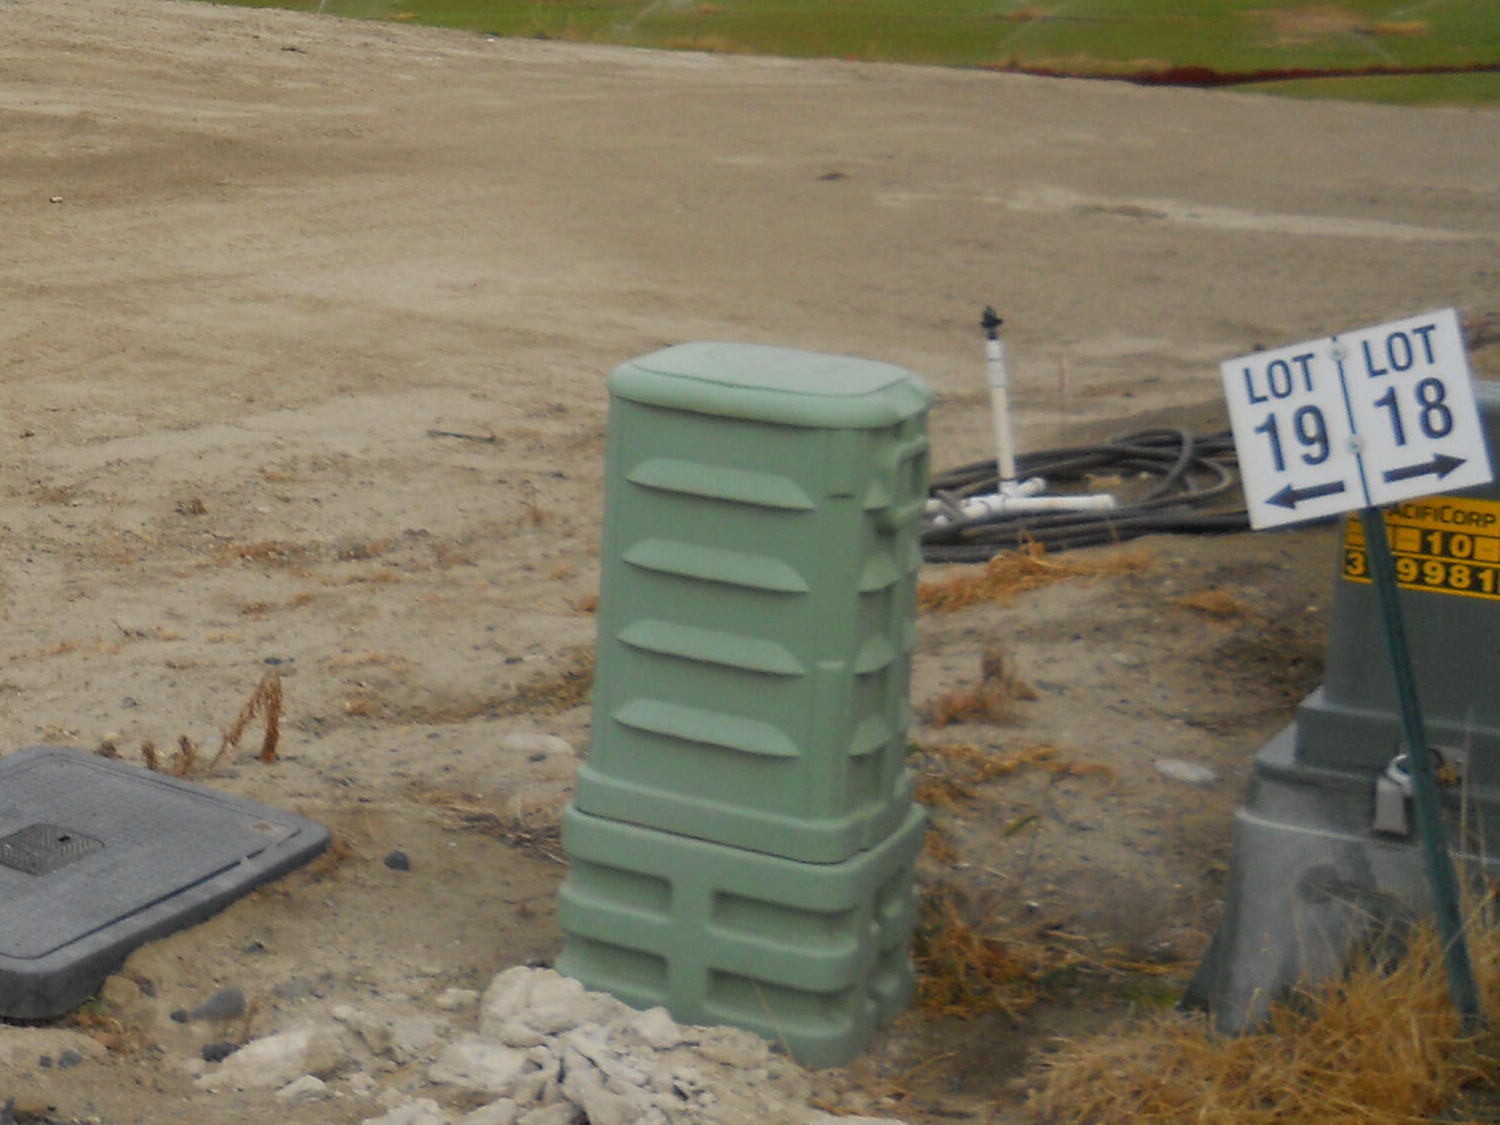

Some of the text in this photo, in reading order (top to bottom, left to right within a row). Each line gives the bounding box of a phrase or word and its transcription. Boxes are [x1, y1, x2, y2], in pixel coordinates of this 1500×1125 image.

[1362, 324, 1436, 377] LOT
[1243, 353, 1315, 405] LOT
[1373, 377, 1454, 446] 18
[1254, 404, 1331, 472] 19
[1427, 531, 1473, 559] 10
[1346, 551, 1495, 593] 39981
